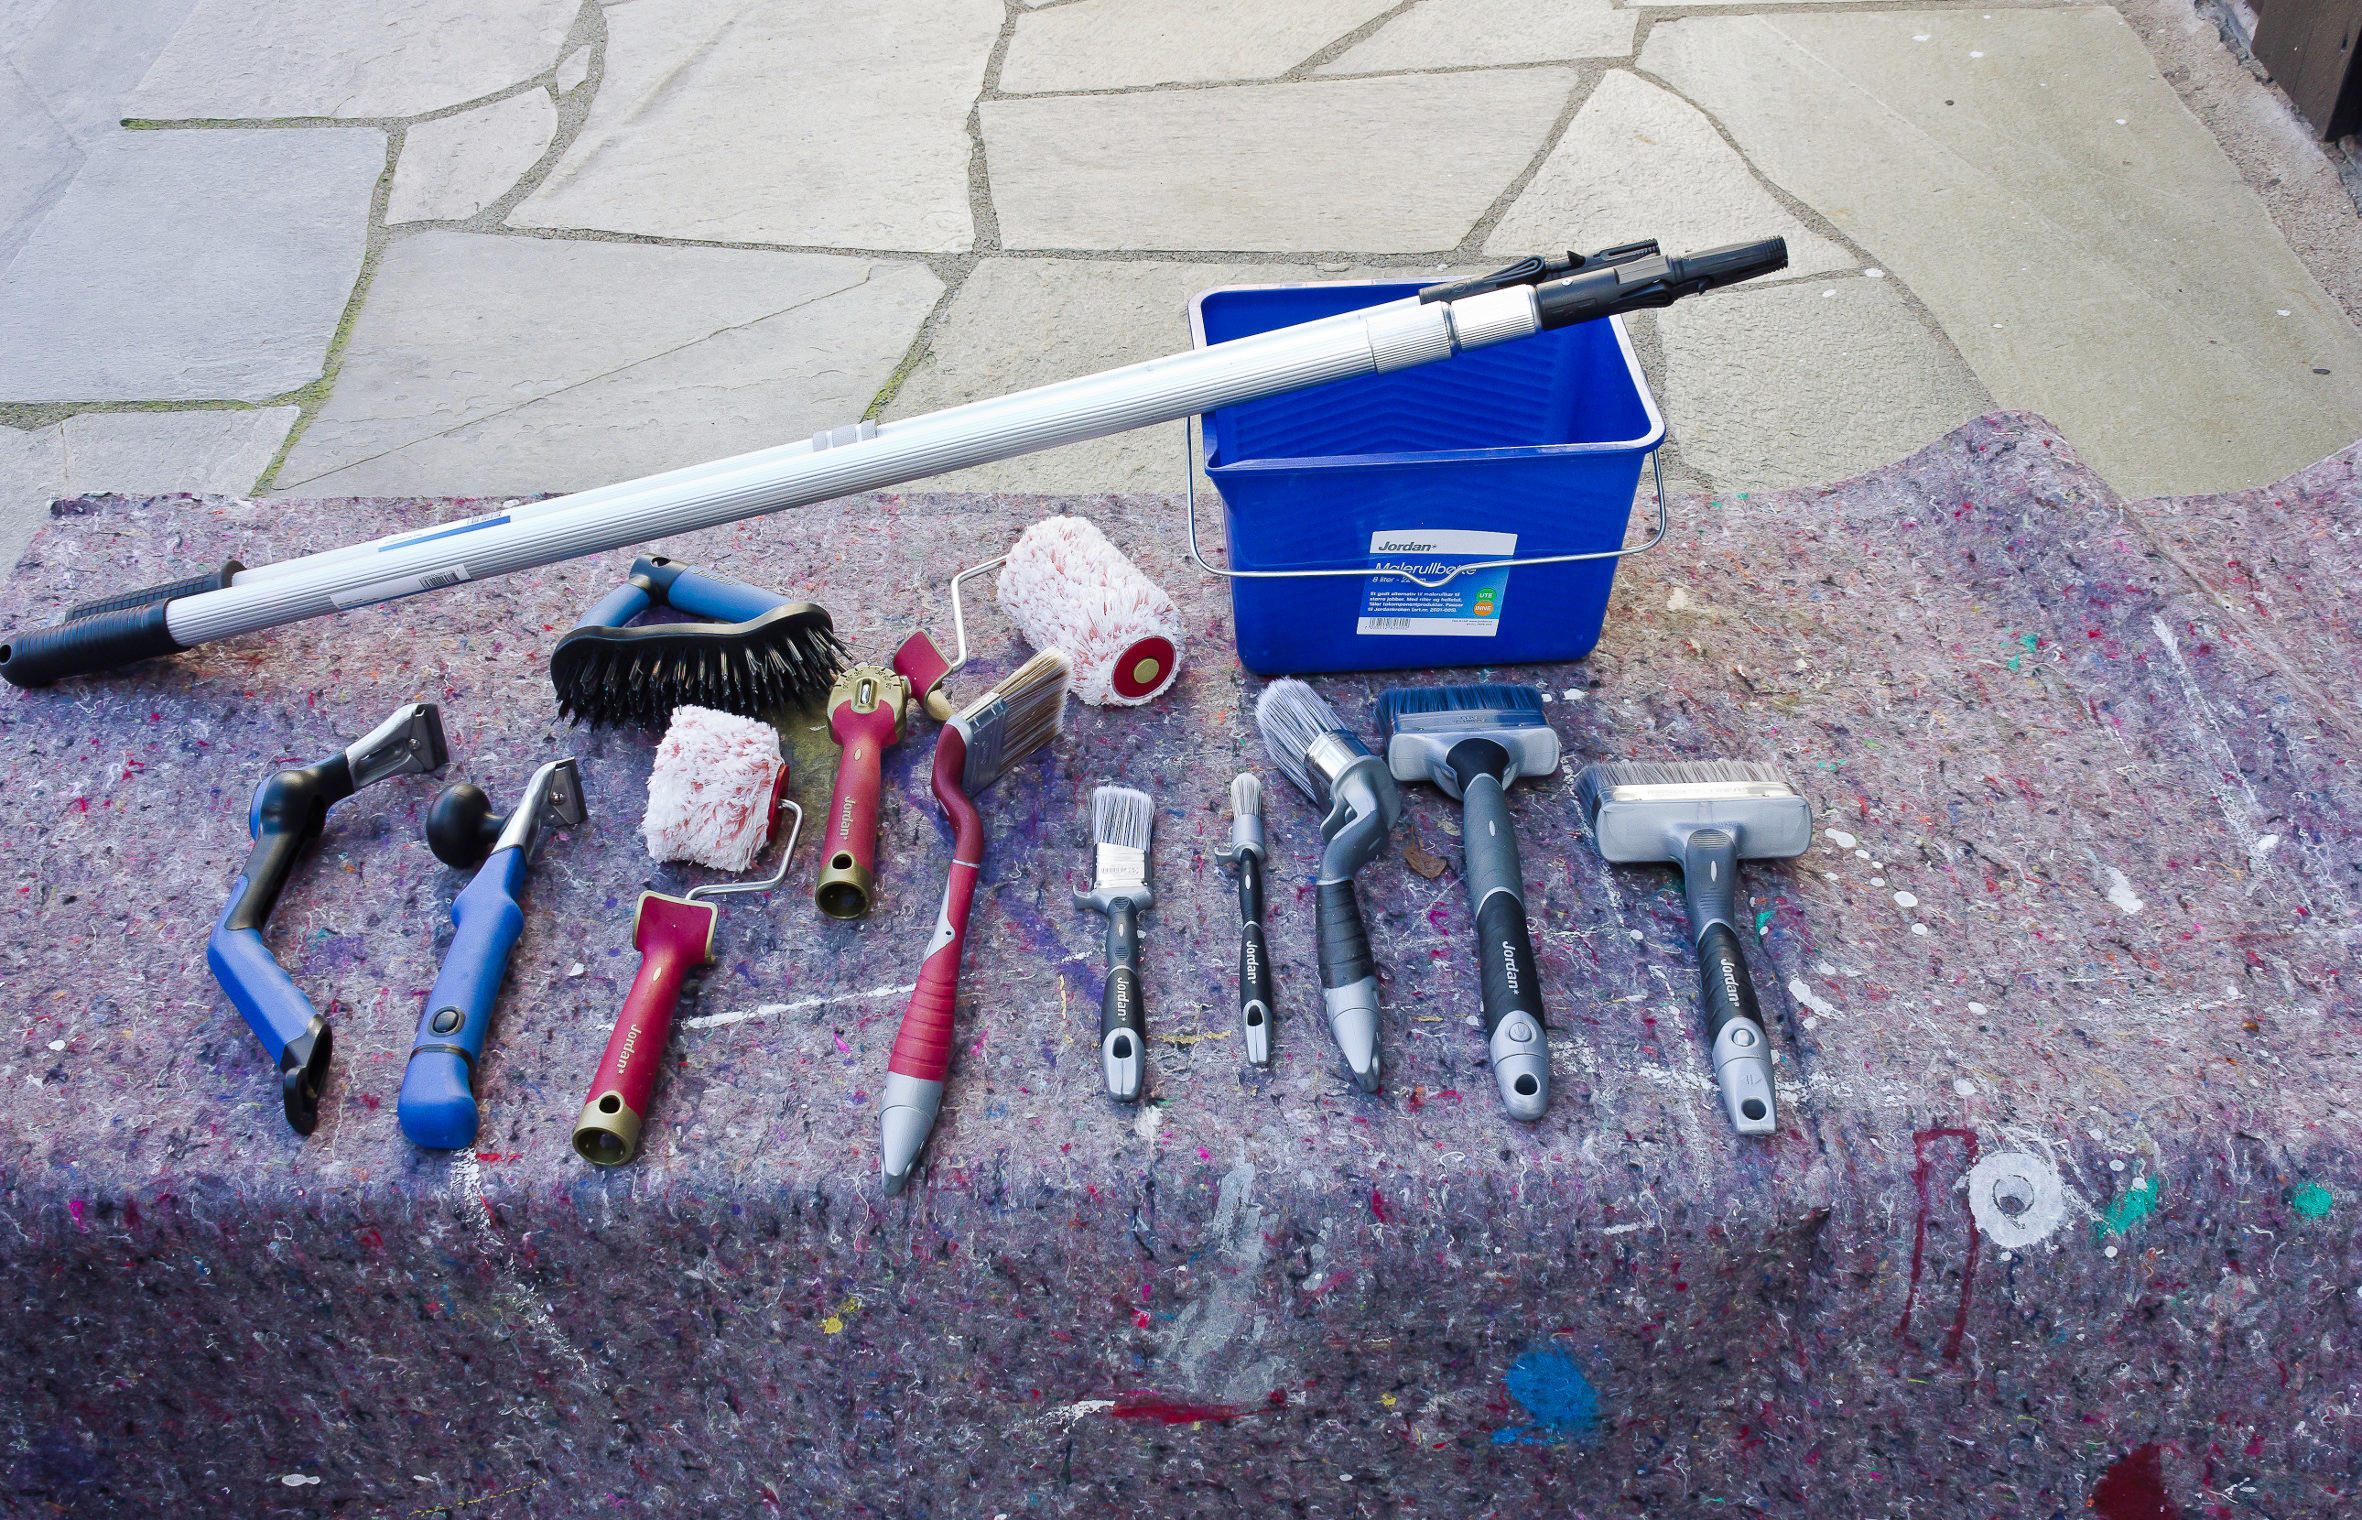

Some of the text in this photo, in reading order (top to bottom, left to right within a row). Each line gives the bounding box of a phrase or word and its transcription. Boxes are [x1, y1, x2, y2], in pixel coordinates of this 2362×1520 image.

[1378, 541, 1431, 551] Jordan
[1375, 562, 1477, 575] Malerullbøe
[840, 796, 856, 836] Jordan
[1246, 940, 1259, 980] Jordan
[1502, 940, 1519, 989] Jordan
[1720, 958, 1739, 1002] Jordan
[1117, 976, 1130, 1016] Jordan
[616, 1024, 642, 1069] Jordan
